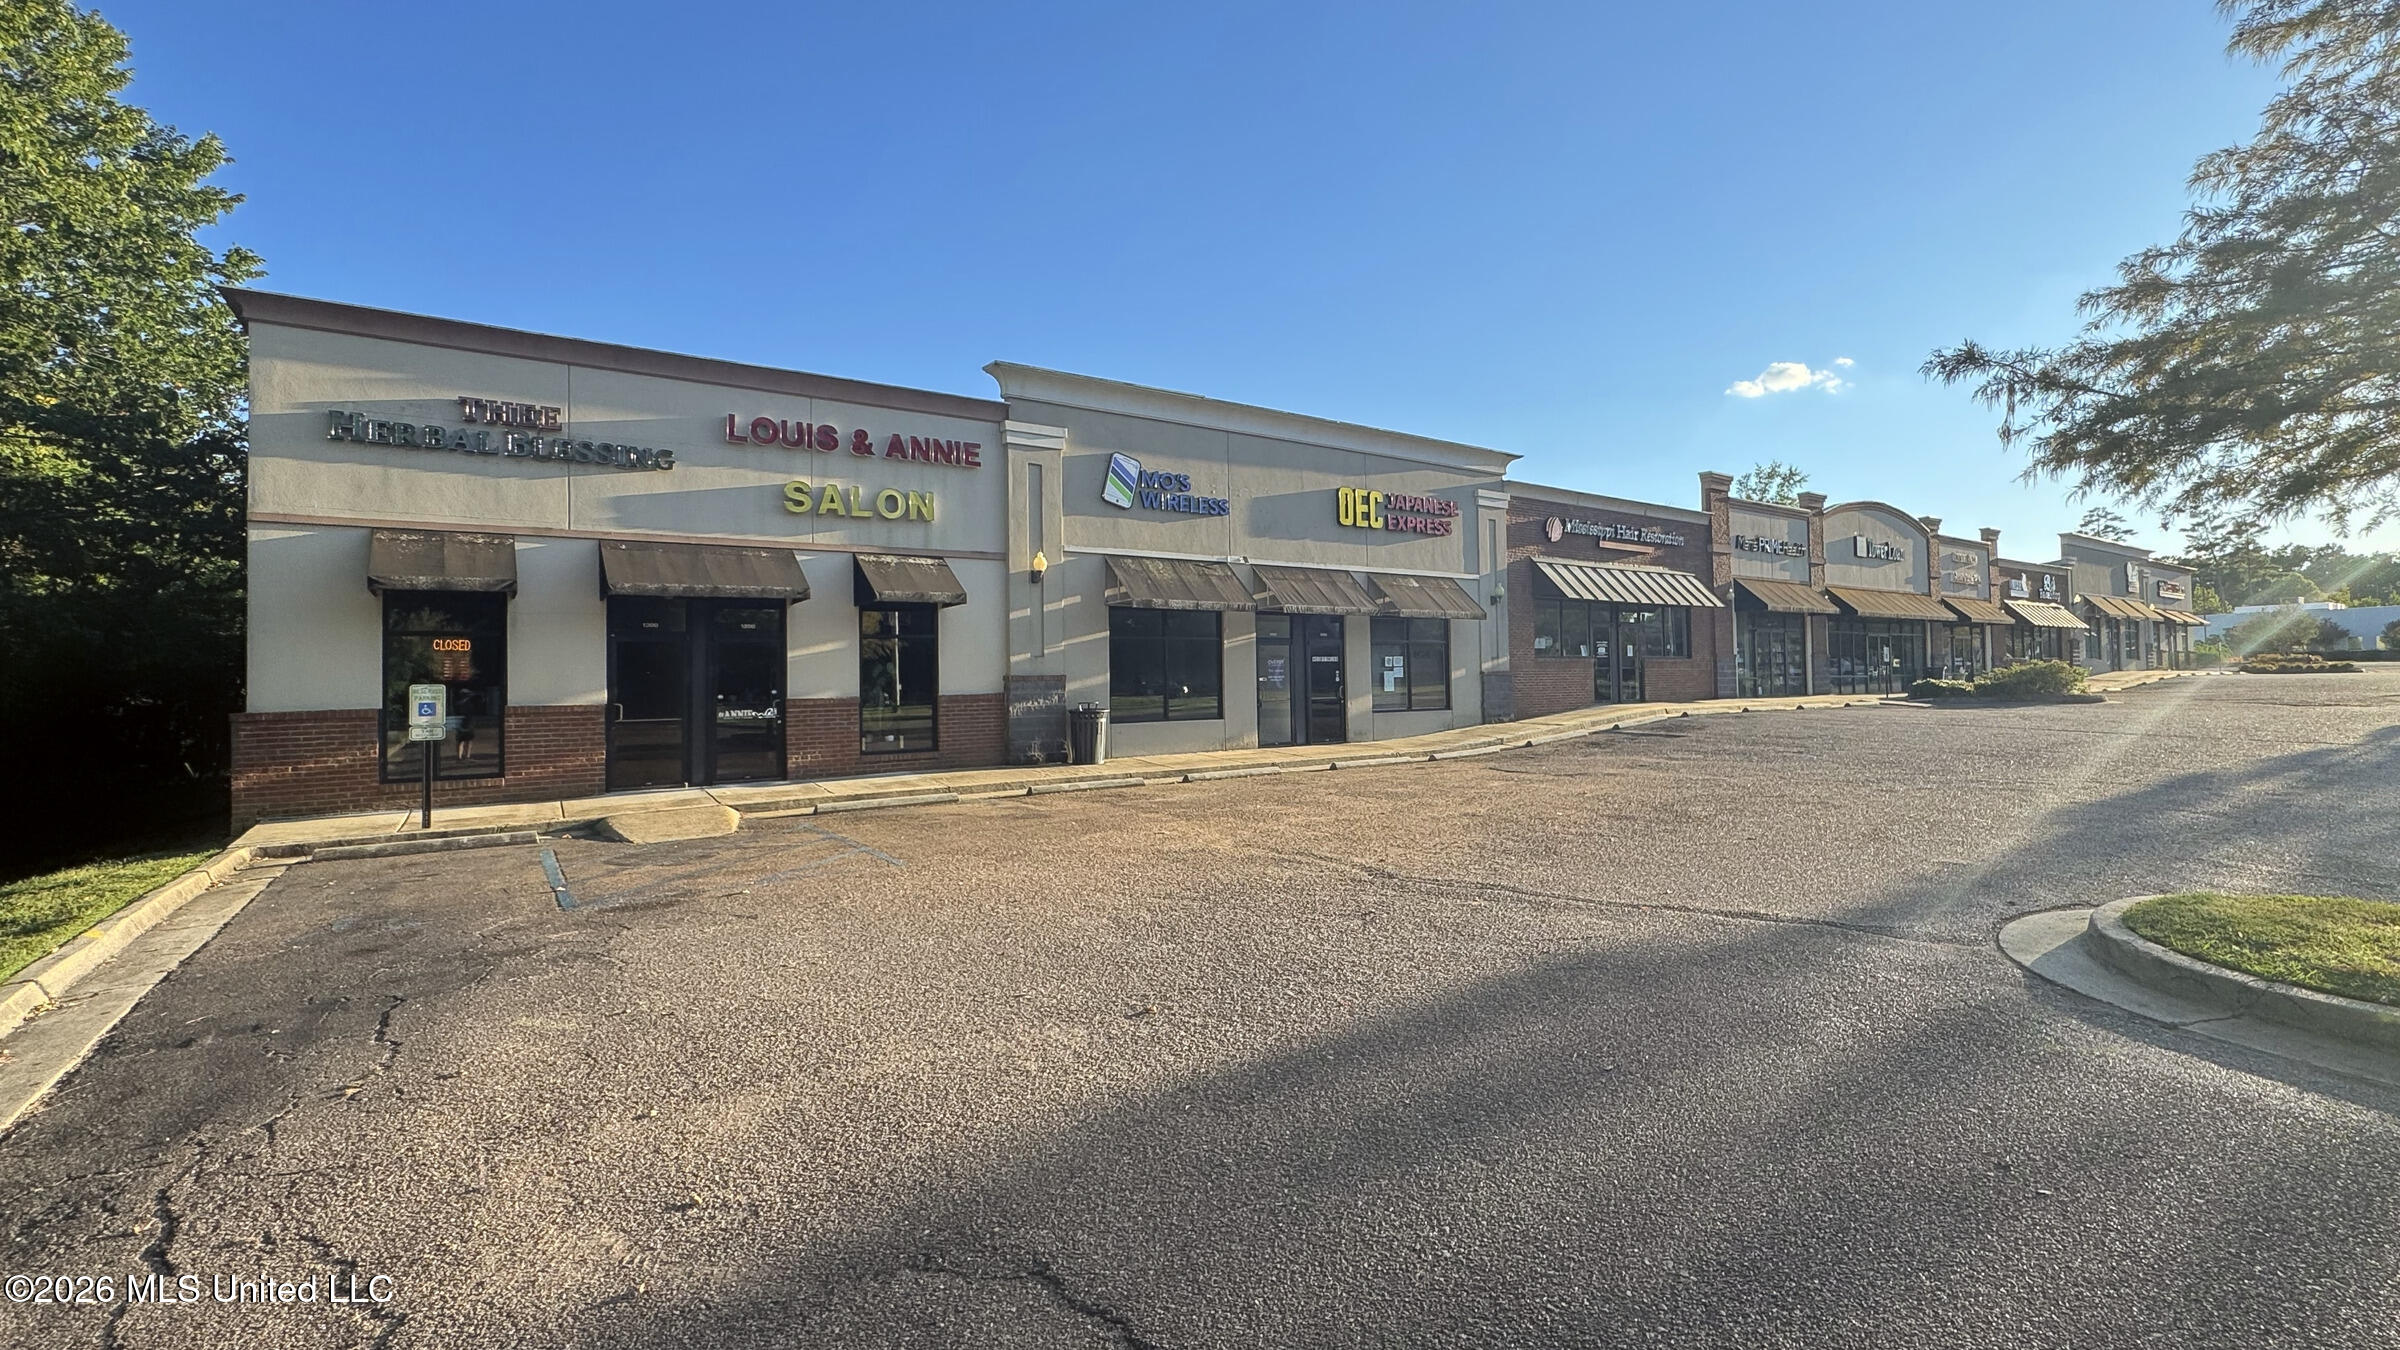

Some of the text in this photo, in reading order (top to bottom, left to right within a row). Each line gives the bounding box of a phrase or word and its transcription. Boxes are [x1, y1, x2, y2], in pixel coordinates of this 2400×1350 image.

[327, 409, 676, 471] HERBAL BLESSING
[726, 412, 982, 469] LOUIS & ANNIE
[1140, 468, 1191, 492] MO'S
[783, 480, 936, 522] SALON
[1139, 490, 1230, 516] WIRELESS
[1337, 486, 1384, 529] OEC
[1386, 492, 1459, 517] JAPANESE
[1386, 513, 1452, 536] EXPRESS
[1564, 518, 1685, 547] Mississippi Hair Restoration
[433, 639, 471, 651] CLOSED
